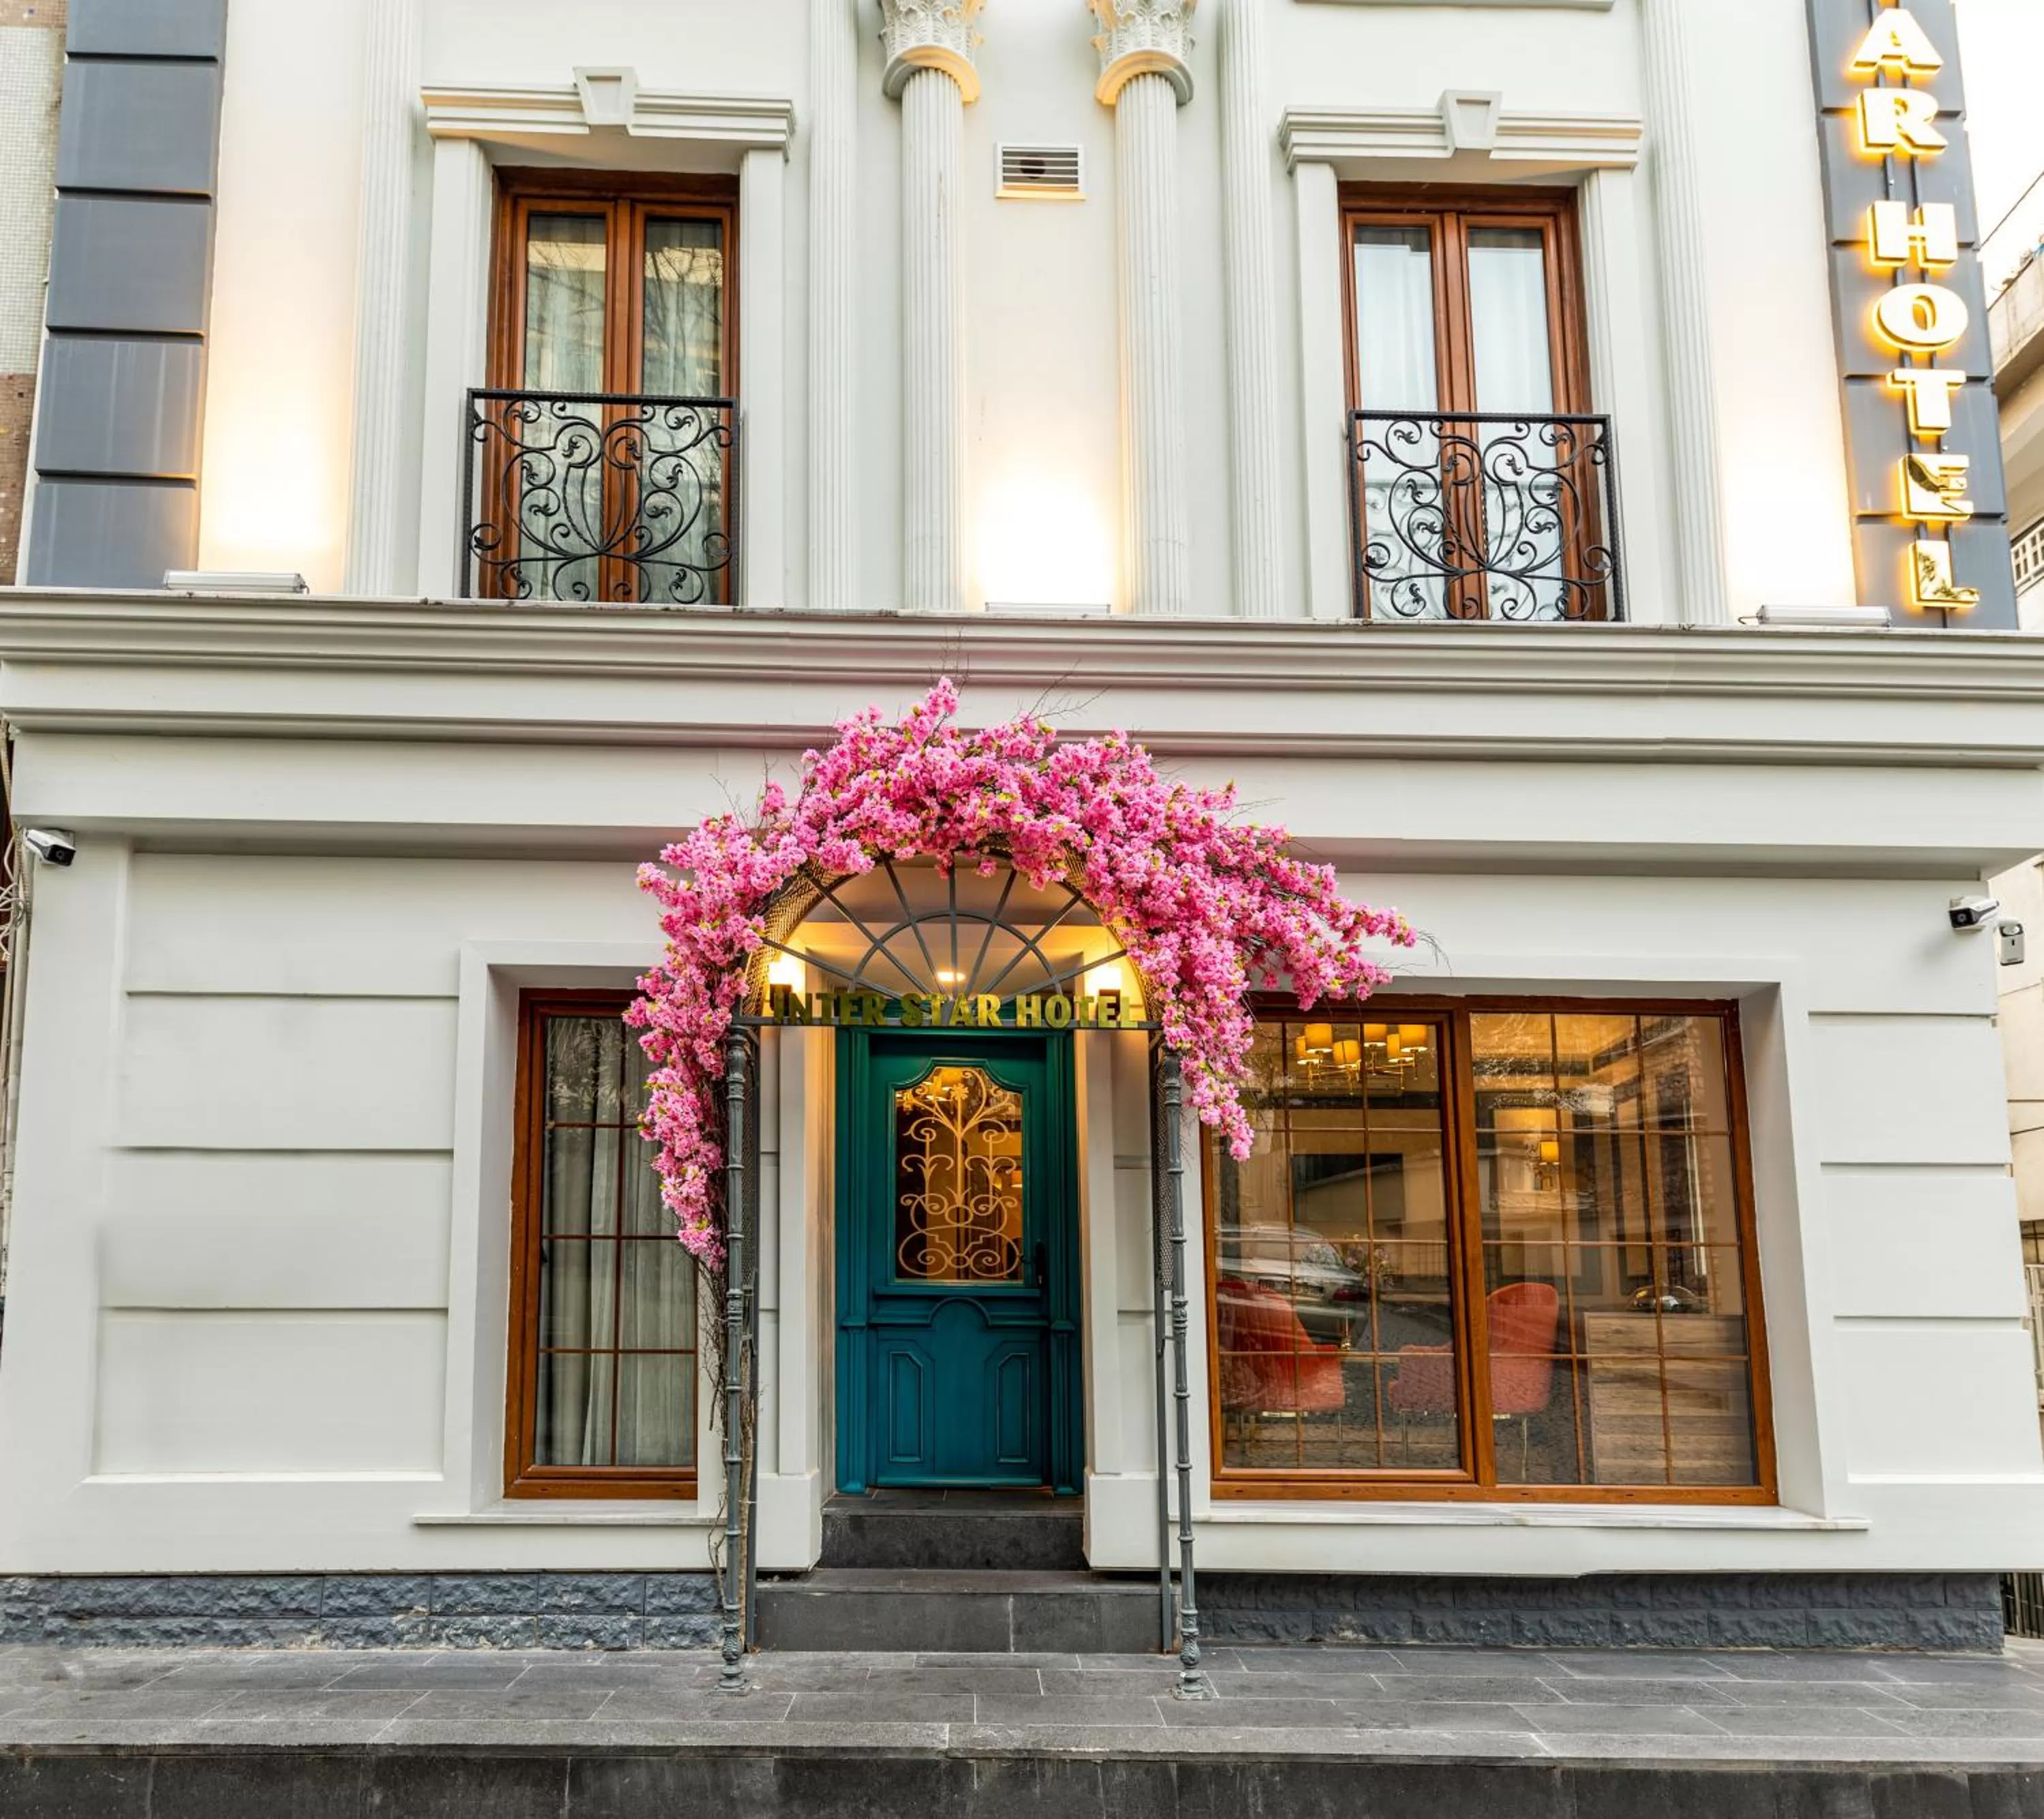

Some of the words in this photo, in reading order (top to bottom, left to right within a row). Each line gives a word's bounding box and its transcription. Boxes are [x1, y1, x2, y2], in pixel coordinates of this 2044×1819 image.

[1867, 200, 1979, 608] HOTEL
[773, 992, 886, 1025] INTER
[901, 993, 1002, 1027] STAR
[1016, 994, 1138, 1029] HOTEL
